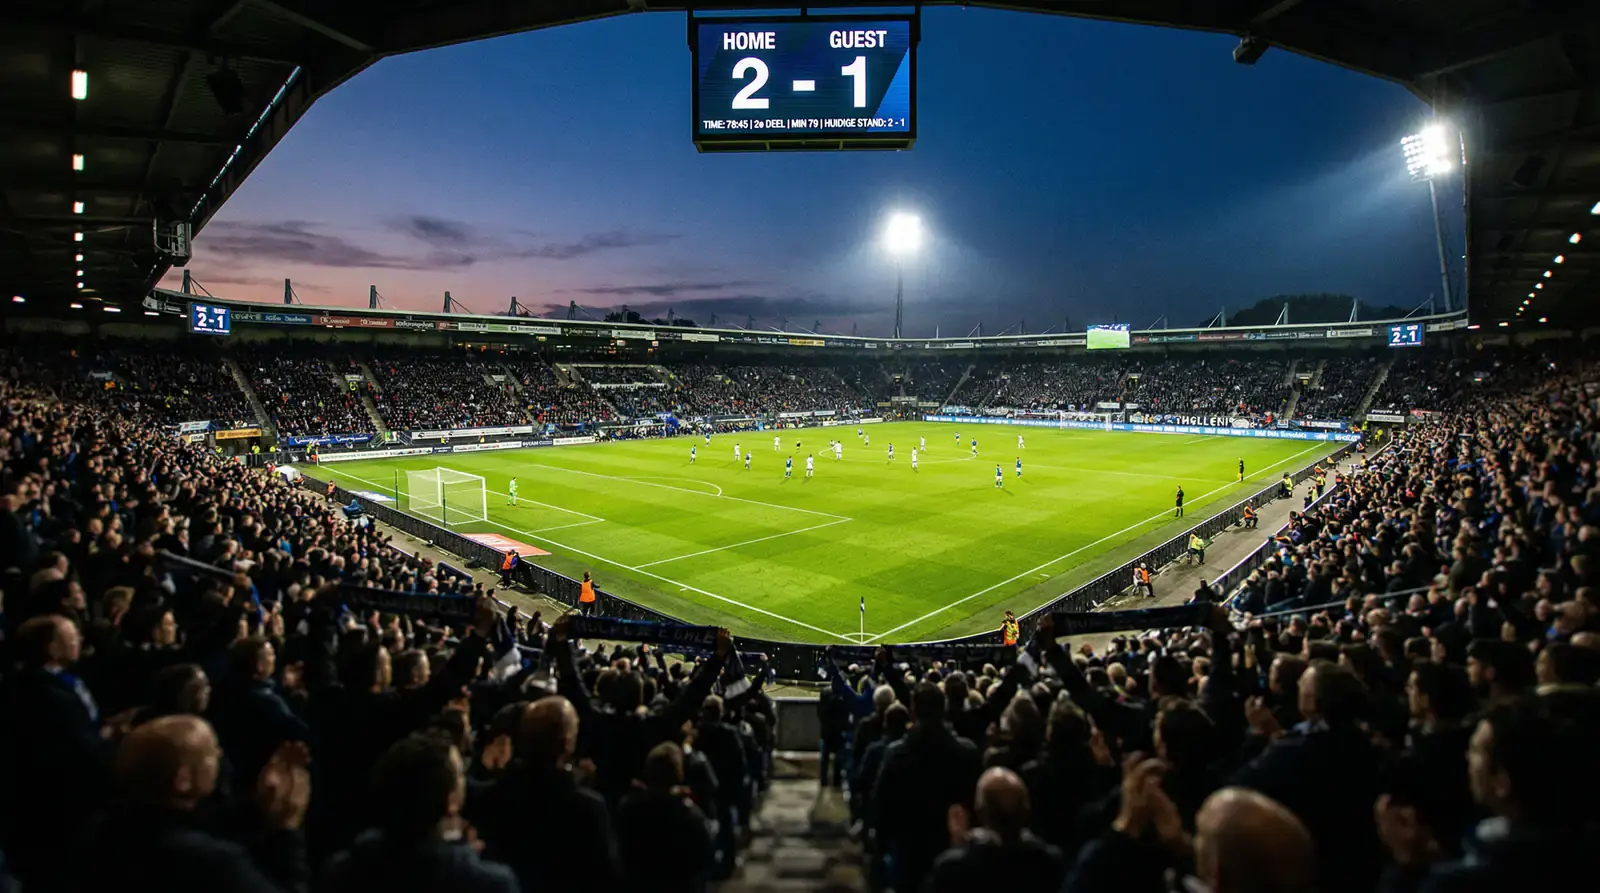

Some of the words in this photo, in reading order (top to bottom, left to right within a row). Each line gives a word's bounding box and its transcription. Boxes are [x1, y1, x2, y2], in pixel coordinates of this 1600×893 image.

[723, 32, 776, 50] HOME
[829, 30, 888, 49] GUEST
[731, 56, 769, 109] 2
[841, 55, 867, 108] 1
[703, 120, 725, 129] TIME:
[726, 119, 749, 129] 78:45
[765, 119, 786, 129] DEEL
[791, 118, 807, 128] MIN
[807, 119, 819, 128] 79
[824, 118, 856, 128] HUIDIGE
[857, 117, 887, 128] STAND:
